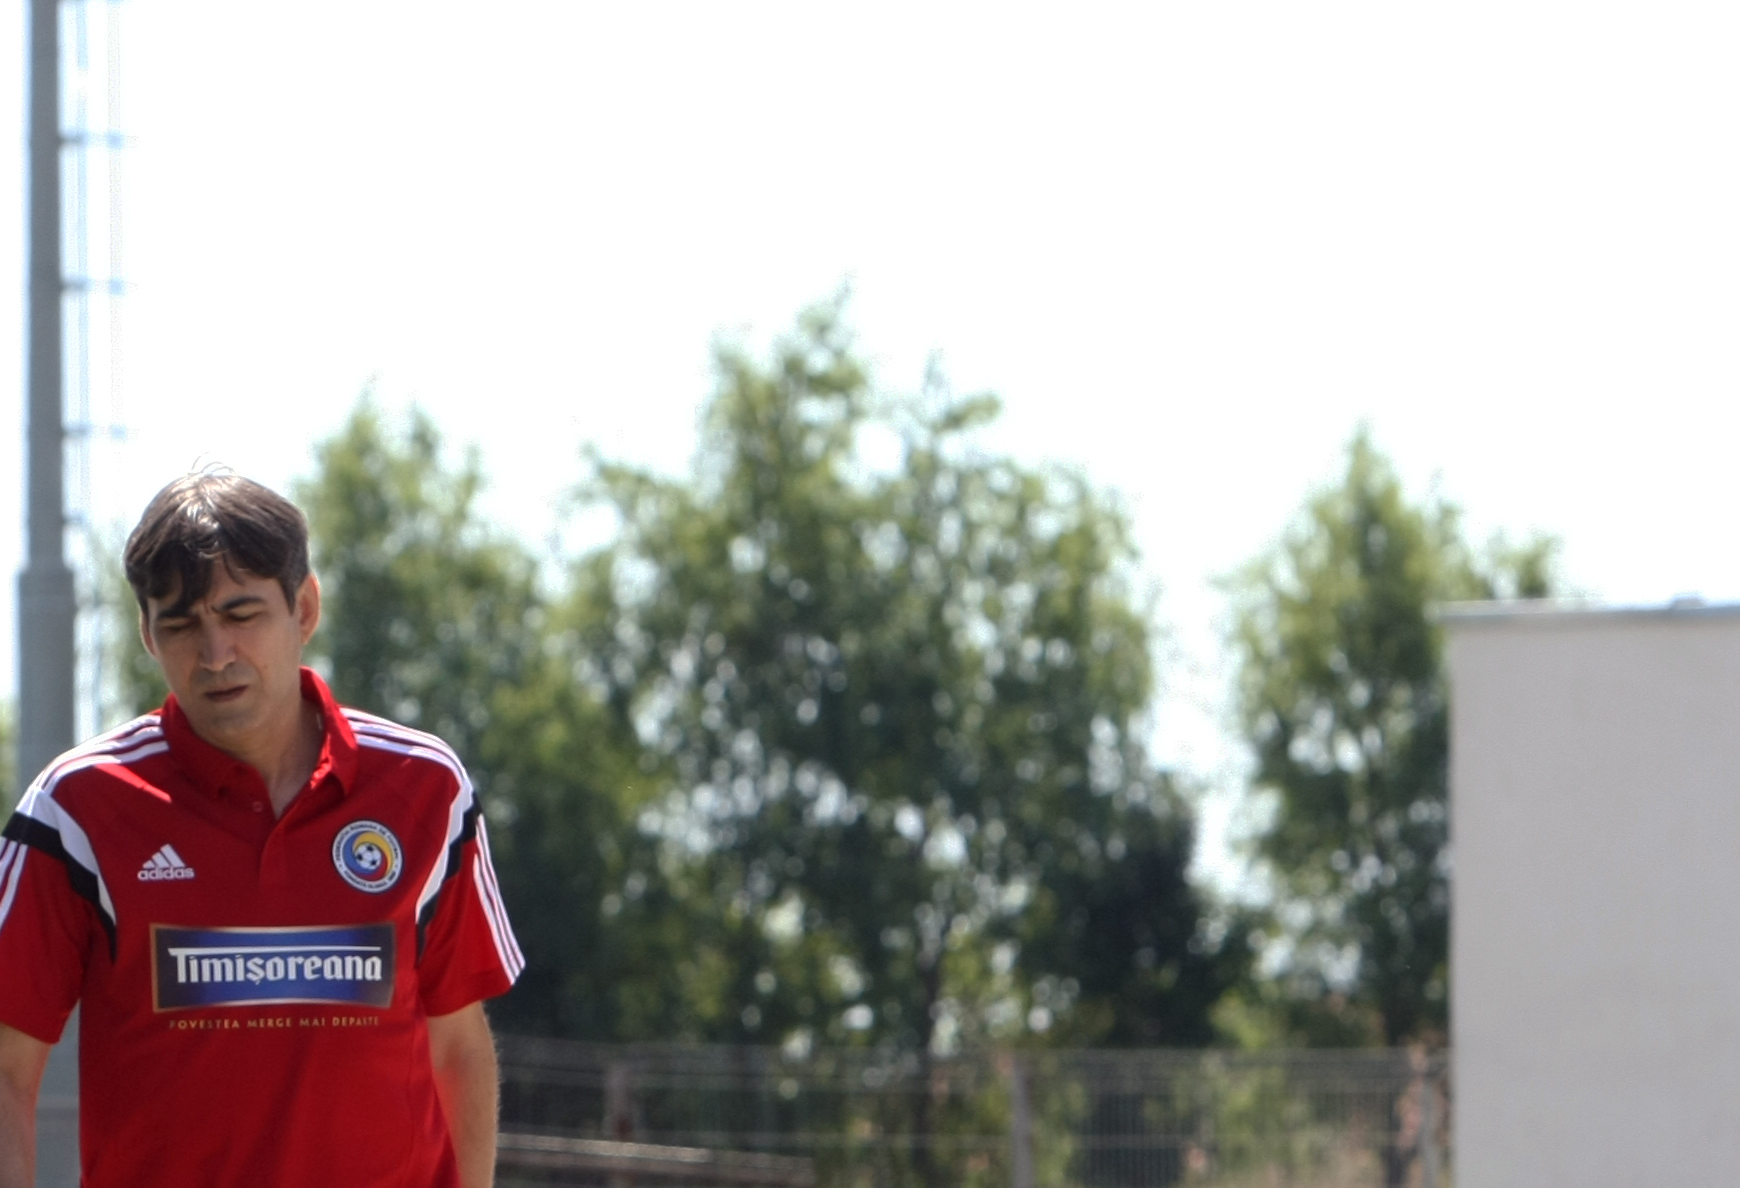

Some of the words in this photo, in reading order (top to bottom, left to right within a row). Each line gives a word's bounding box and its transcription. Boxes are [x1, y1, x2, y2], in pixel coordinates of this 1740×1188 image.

[137, 866, 195, 881] adidas
[168, 1018, 240, 1030] POVESTEA
[247, 1016, 292, 1028] MERGE
[299, 1016, 325, 1027] MAI
